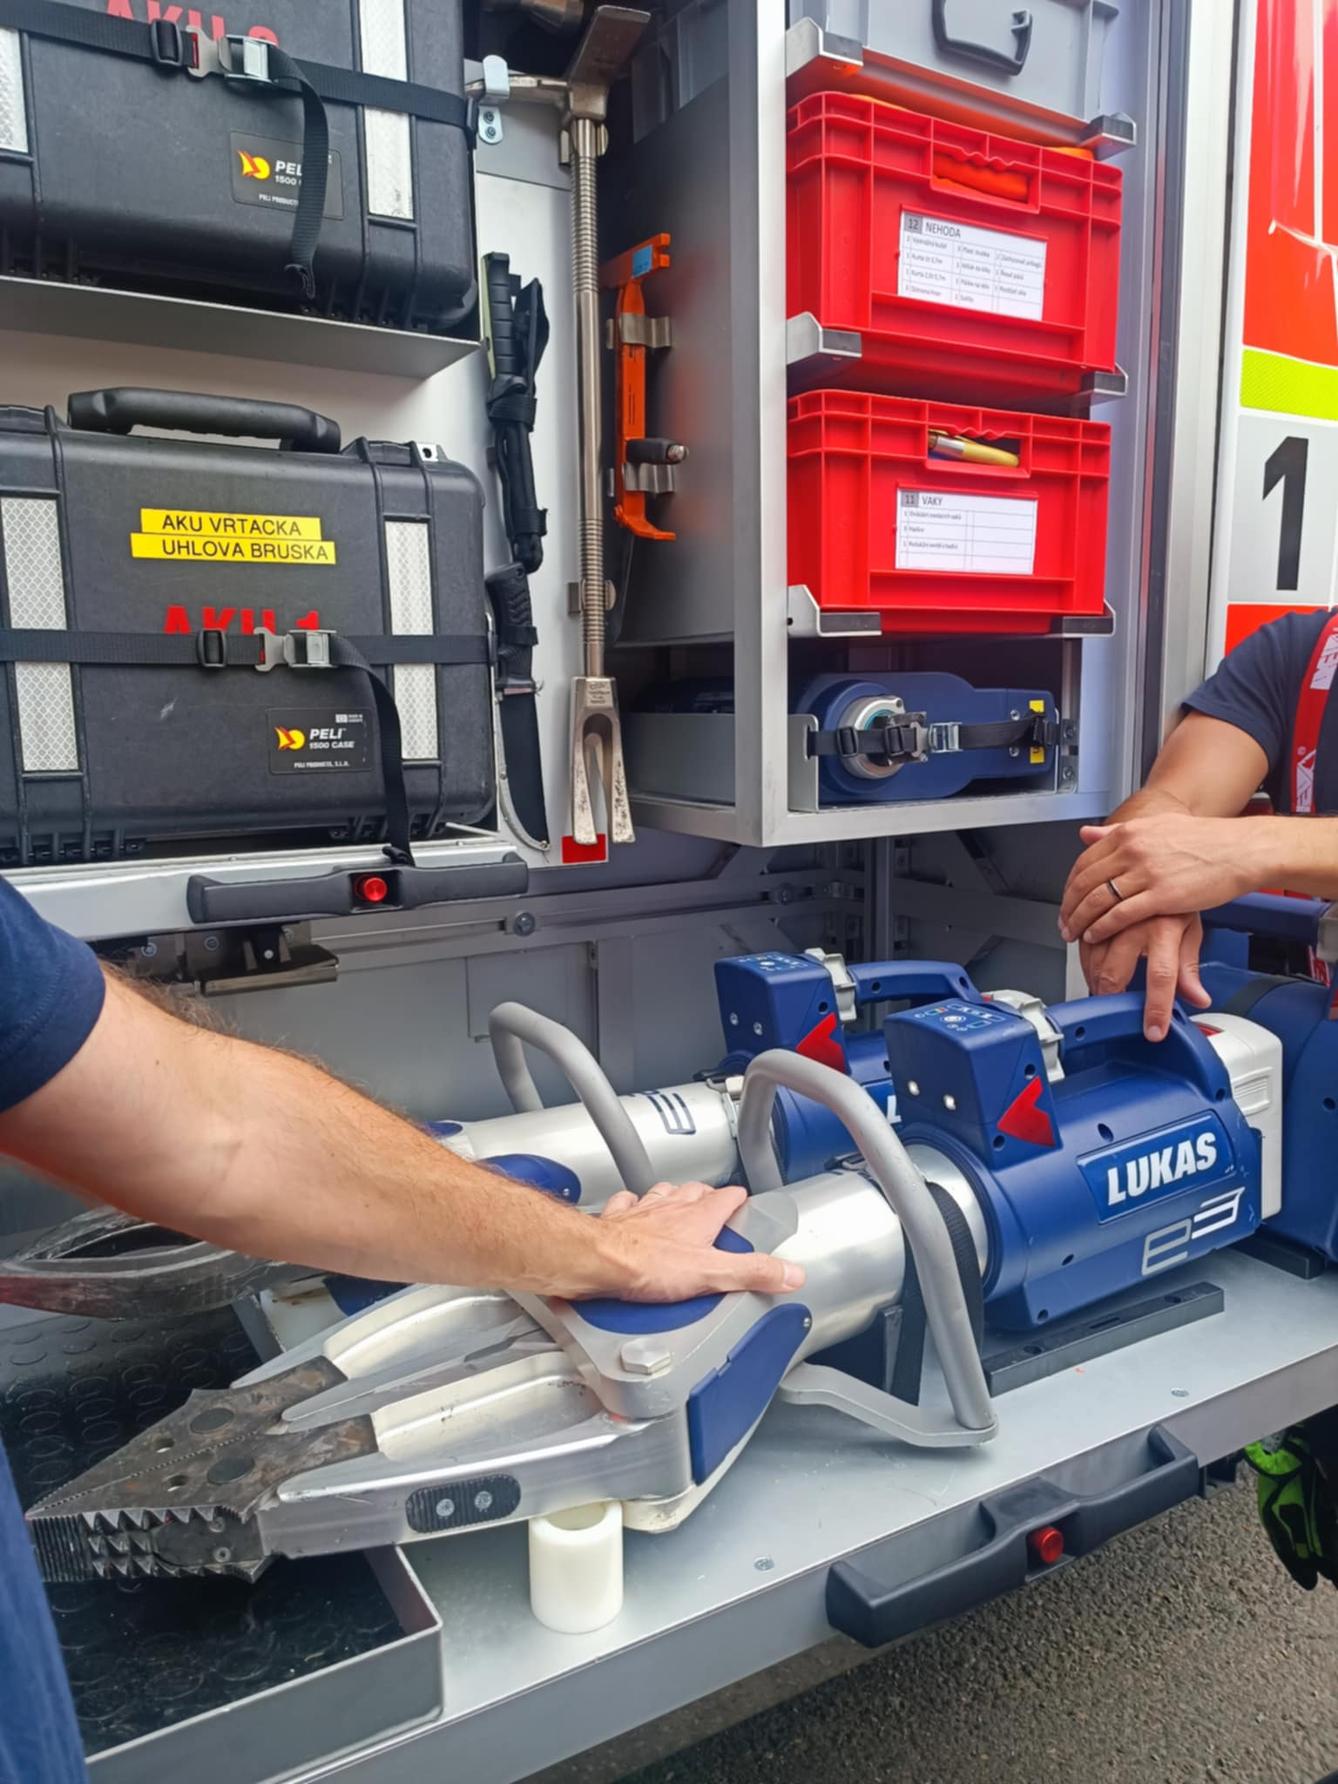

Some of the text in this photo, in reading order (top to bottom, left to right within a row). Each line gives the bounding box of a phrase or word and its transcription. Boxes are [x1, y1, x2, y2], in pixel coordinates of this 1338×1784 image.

[275, 160, 303, 176] PEL
[908, 218, 961, 238] 12 NEHODA
[1262, 436, 1309, 590] 1
[162, 515, 302, 536] AKU VRTACKA
[162, 539, 329, 560] UHLOVA BRUSKA
[310, 728, 343, 740] PELI
[309, 741, 355, 750] 1500 CASE
[1107, 1132, 1217, 1206] LUKAS
